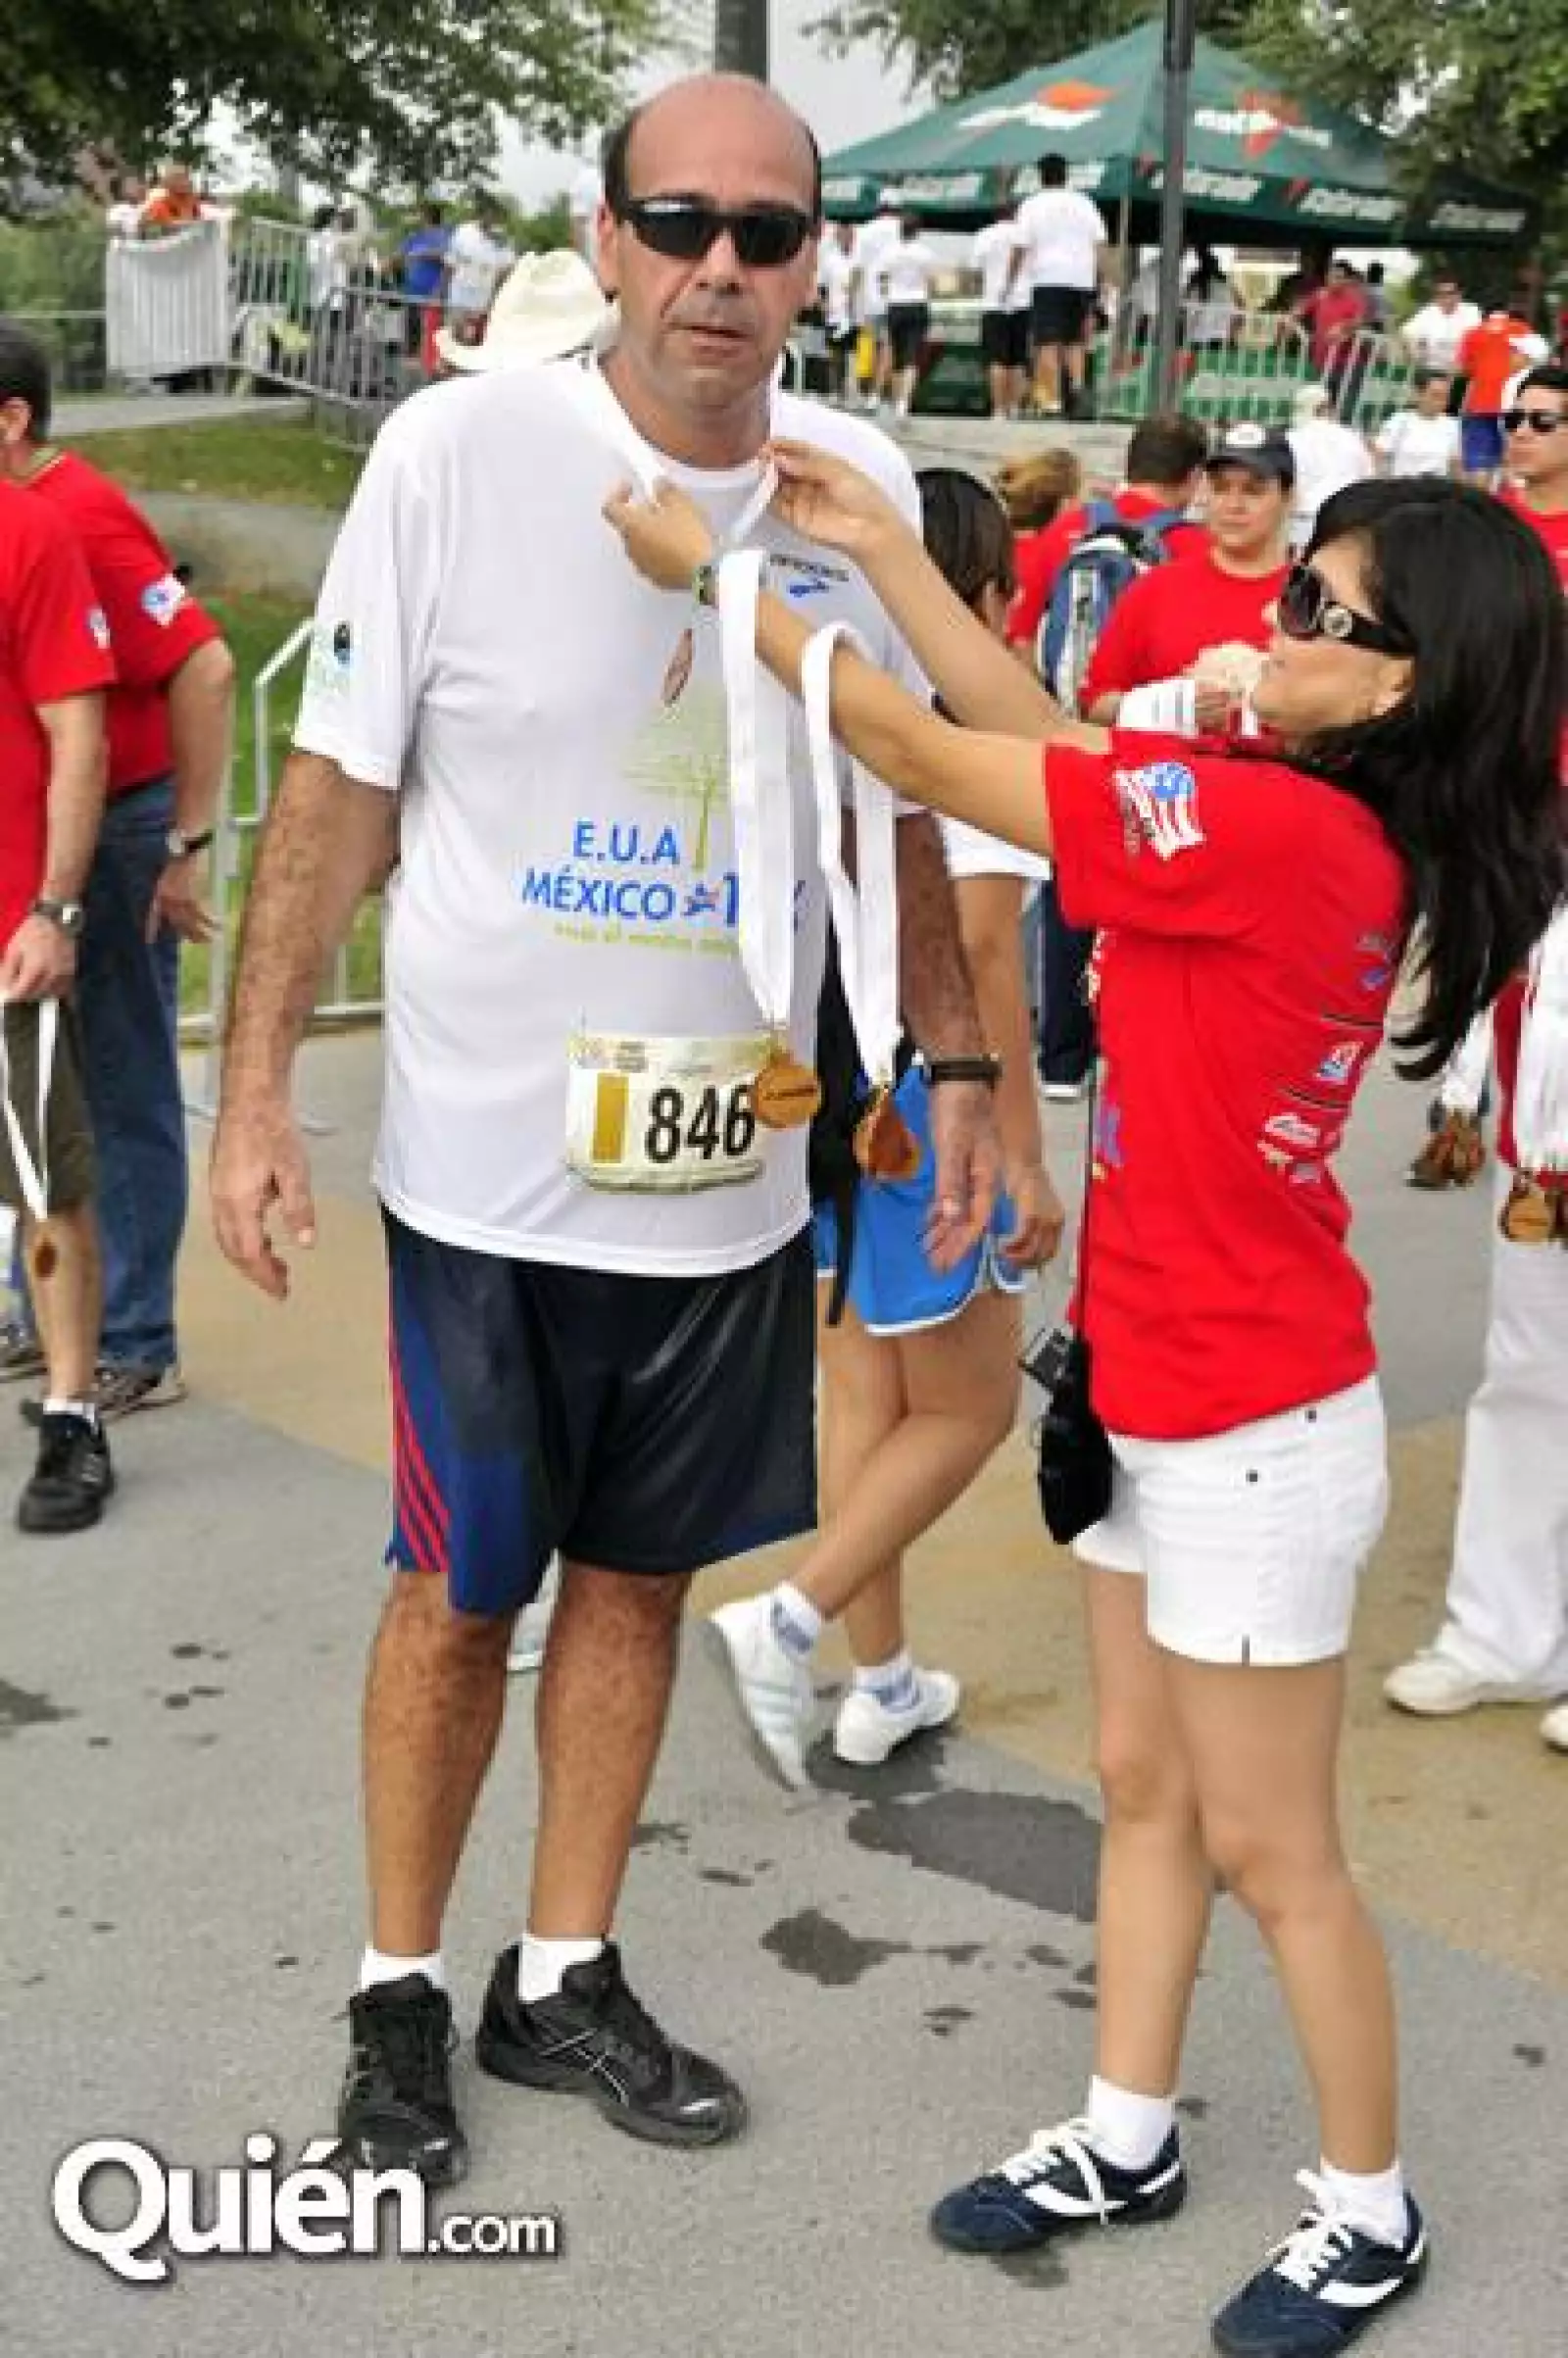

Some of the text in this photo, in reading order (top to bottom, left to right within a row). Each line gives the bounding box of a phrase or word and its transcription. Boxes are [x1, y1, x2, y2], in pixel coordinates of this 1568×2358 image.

[572, 820, 681, 865] E.U.A
[521, 864, 676, 920] MÉXICO
[644, 1085, 757, 1163] 846
